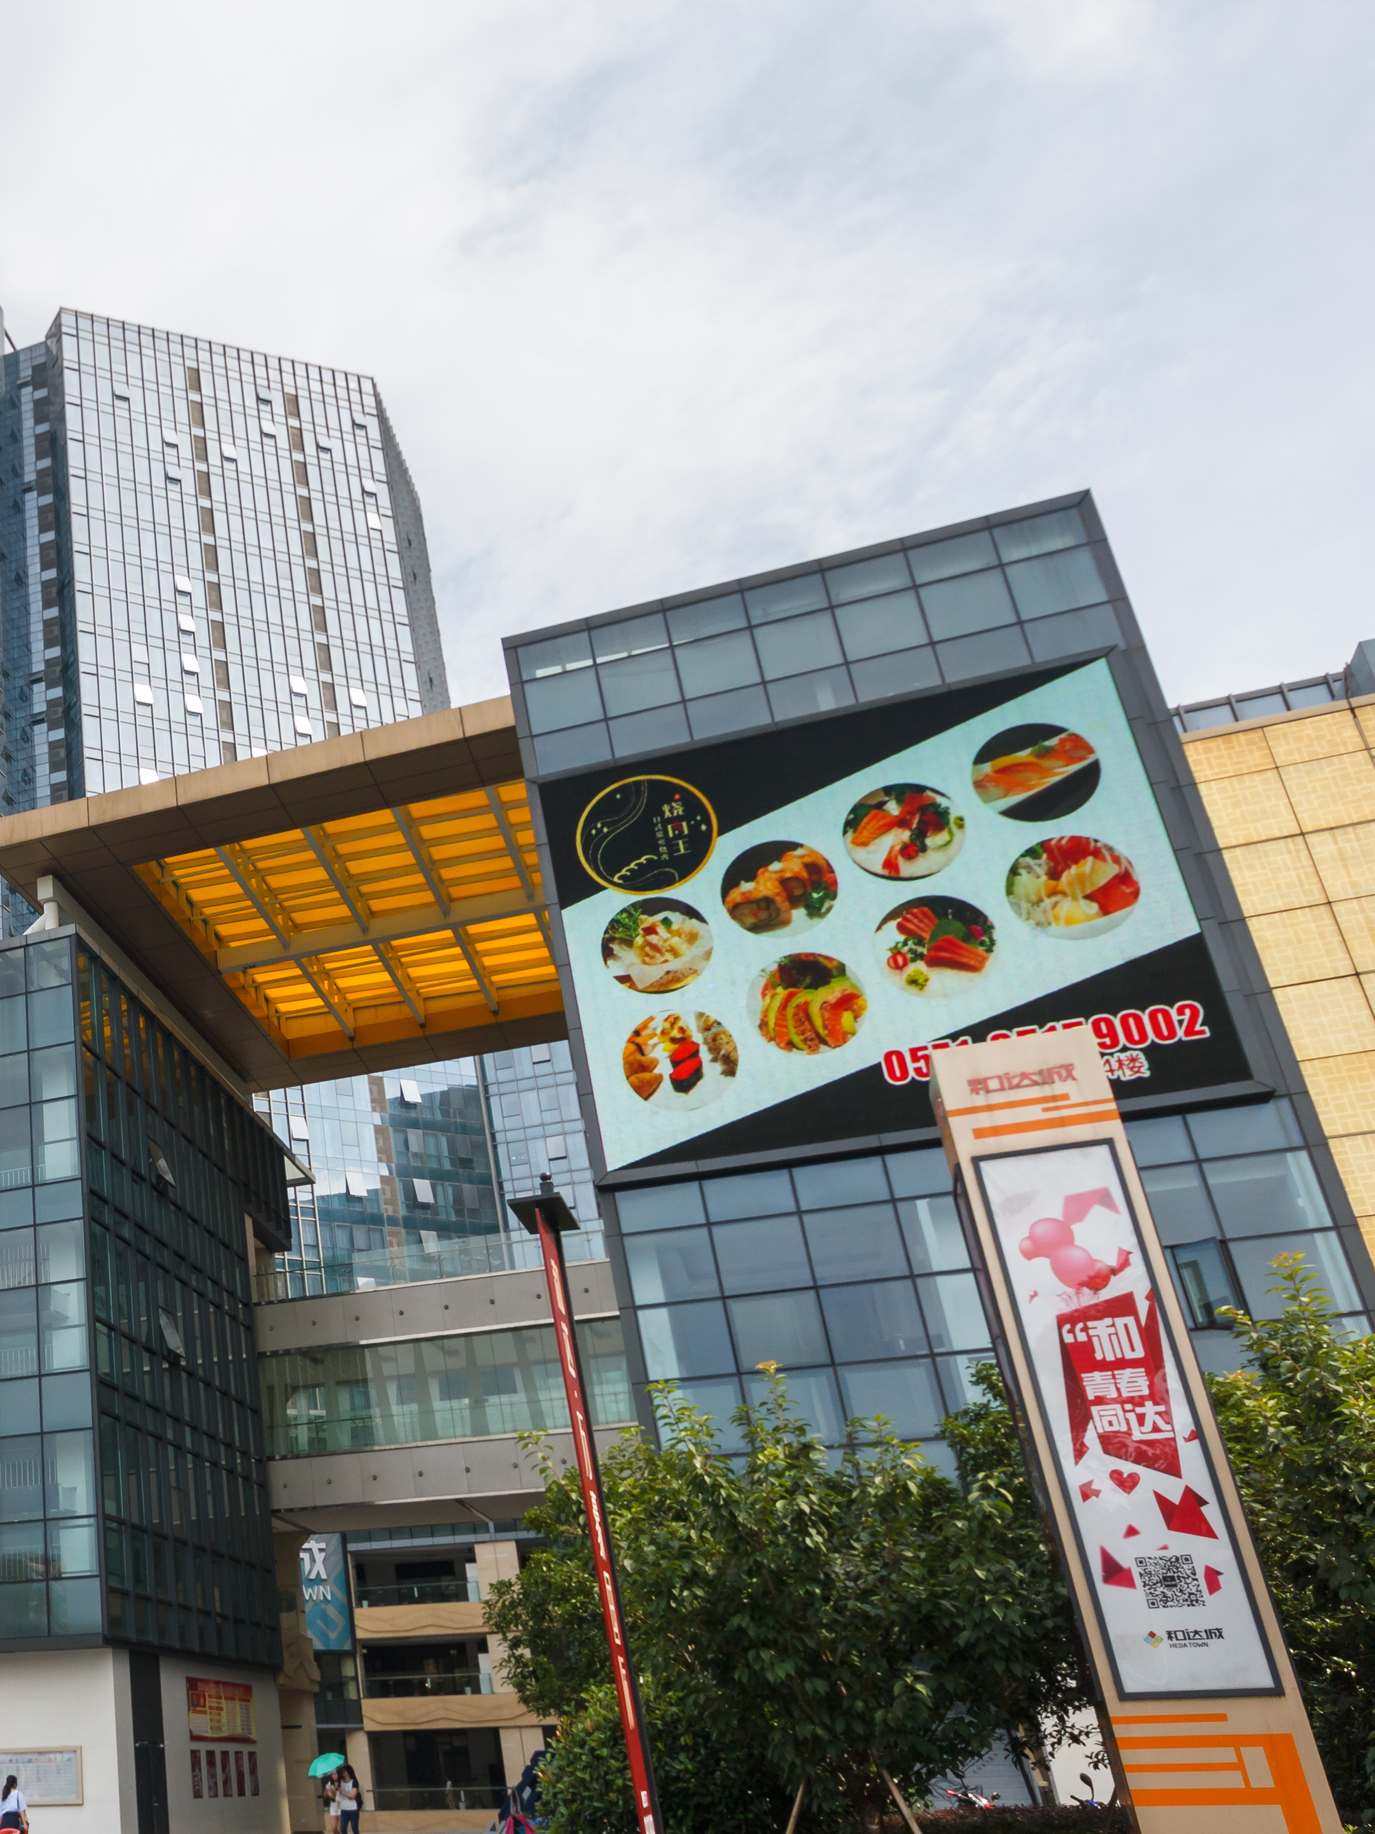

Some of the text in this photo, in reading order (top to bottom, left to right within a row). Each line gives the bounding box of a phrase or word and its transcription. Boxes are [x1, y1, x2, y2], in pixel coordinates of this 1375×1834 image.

[967, 1062, 1077, 1096] 和达城
[1081, 1367, 1150, 1400] 青春
[1090, 1400, 1175, 1441] 同达
[1165, 1627, 1225, 1642] 和达城
